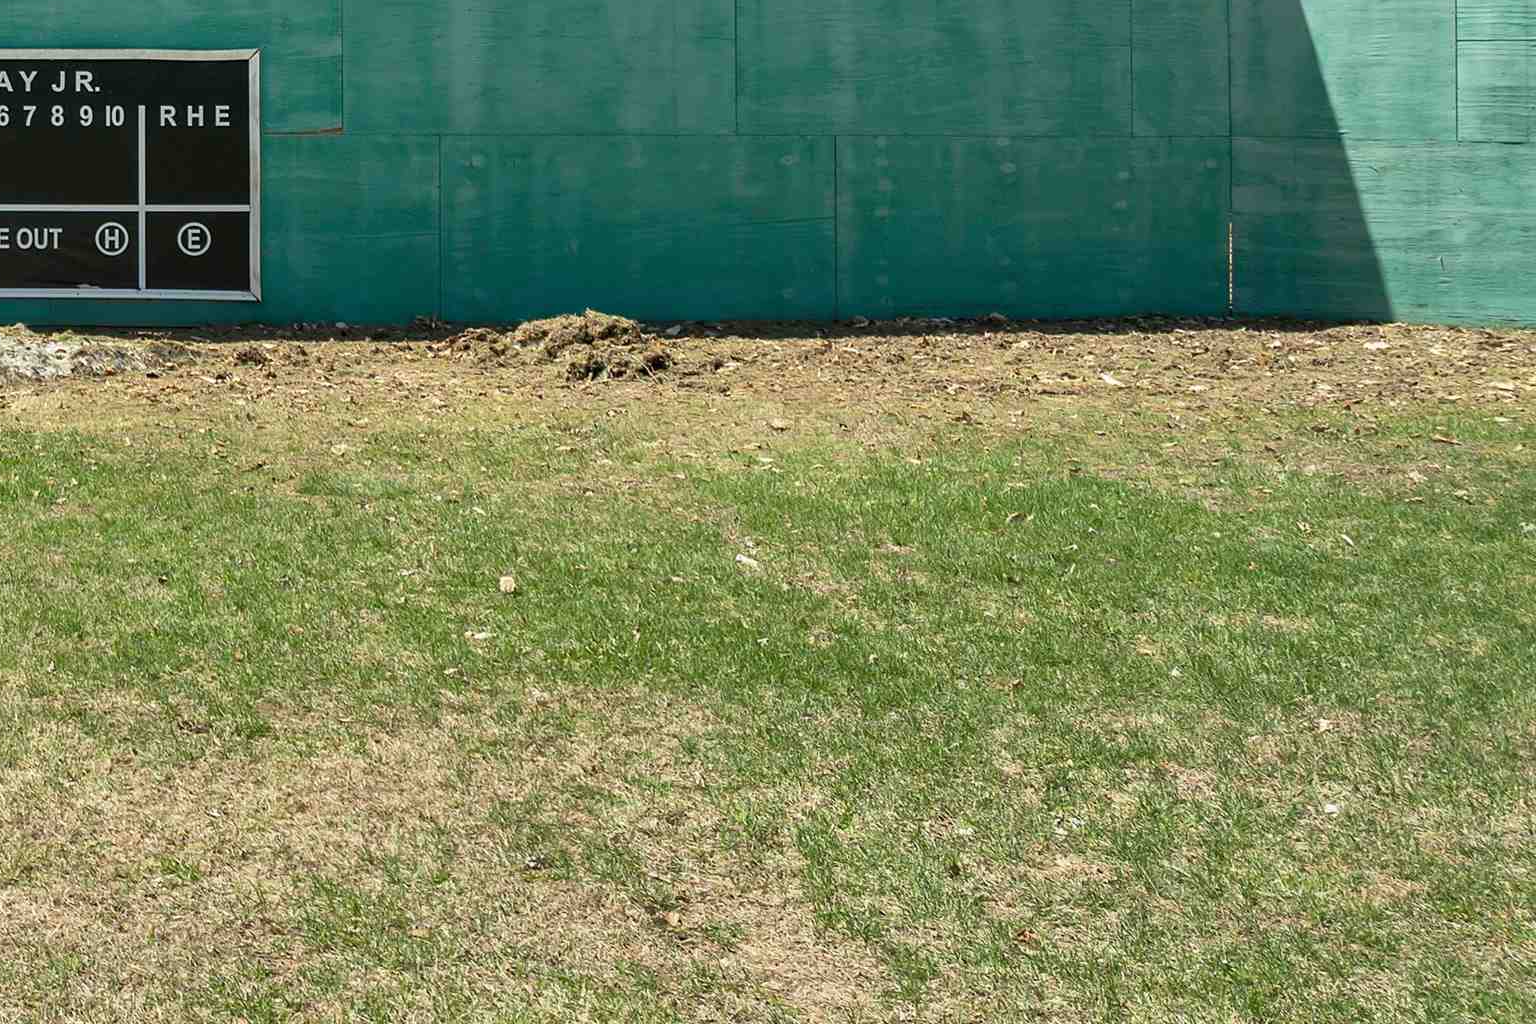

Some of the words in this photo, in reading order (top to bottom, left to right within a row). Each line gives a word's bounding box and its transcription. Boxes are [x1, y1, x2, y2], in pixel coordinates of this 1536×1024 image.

[52, 71, 100, 92] JR.
[24, 106, 36, 126] 7
[51, 105, 64, 126] 8
[80, 105, 93, 126] 9
[160, 106, 176, 126] R
[188, 105, 203, 126] H
[216, 105, 229, 126] E
[17, 228, 62, 249] OUT
[103, 230, 122, 250] H
[188, 230, 200, 249] E
